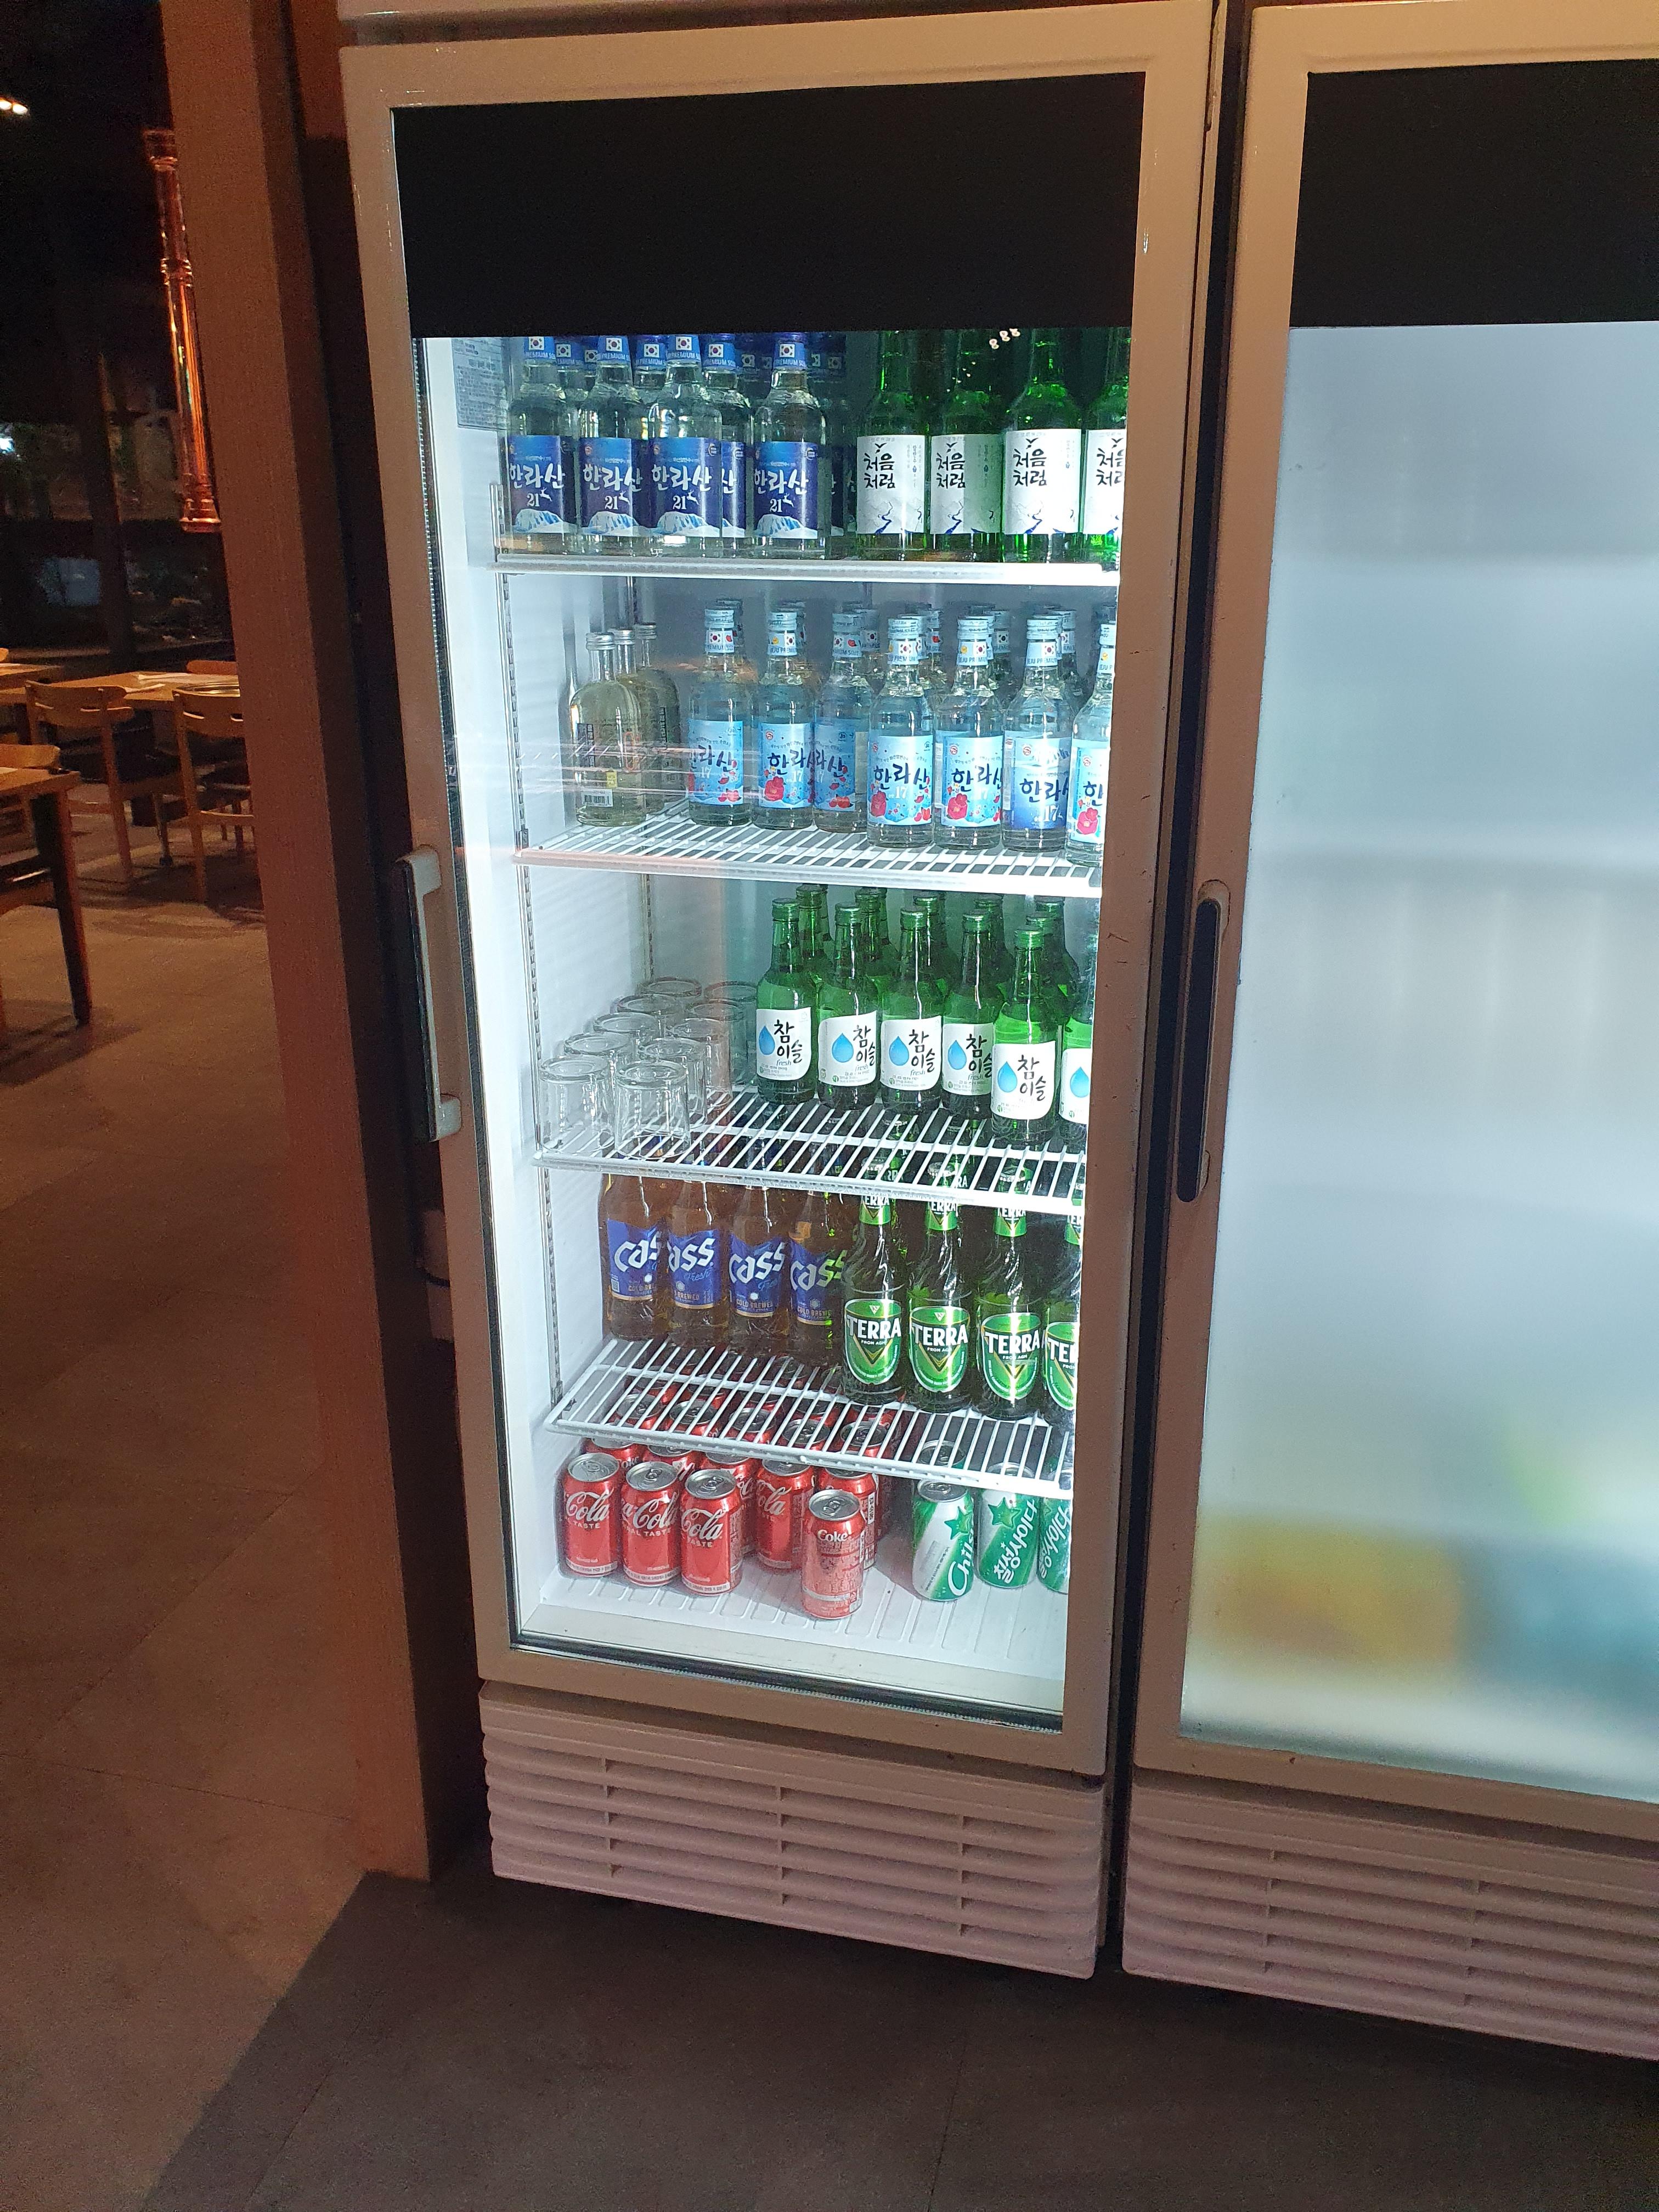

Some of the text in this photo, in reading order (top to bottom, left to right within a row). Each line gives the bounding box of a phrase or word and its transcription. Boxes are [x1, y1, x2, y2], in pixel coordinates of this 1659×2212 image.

[864, 453, 895, 471] 처음
[936, 452, 965, 471] 처음
[1013, 448, 1047, 467] 처음
[510, 462, 565, 489] 한라산
[583, 464, 643, 492] 한라산
[652, 464, 712, 492] 한라산
[754, 467, 809, 494] 한라산
[864, 473, 895, 489] 처럼
[936, 472, 966, 489] 처럼
[1013, 470, 1047, 487] 처럼
[527, 493, 540, 507] 21
[605, 495, 618, 510] 21
[673, 495, 686, 510] 21
[770, 499, 782, 512] 21
[873, 762, 928, 790] 한라산
[895, 786, 909, 800] 17
[1043, 805, 1059, 822] 17
[774, 1019, 794, 1043] 참
[853, 1025, 871, 1048] 참
[909, 1029, 929, 1053] 참
[966, 1034, 987, 1058] 참
[1017, 1054, 1040, 1080] 참
[847, 1314, 902, 1339] TERRA
[912, 1322, 968, 1346] TERRA
[985, 1329, 1040, 1354] TERRA
[644, 1527, 671, 1537] TASTE
[817, 1529, 848, 1542] Coke
[994, 1499, 1036, 1584] 칠성사이다
